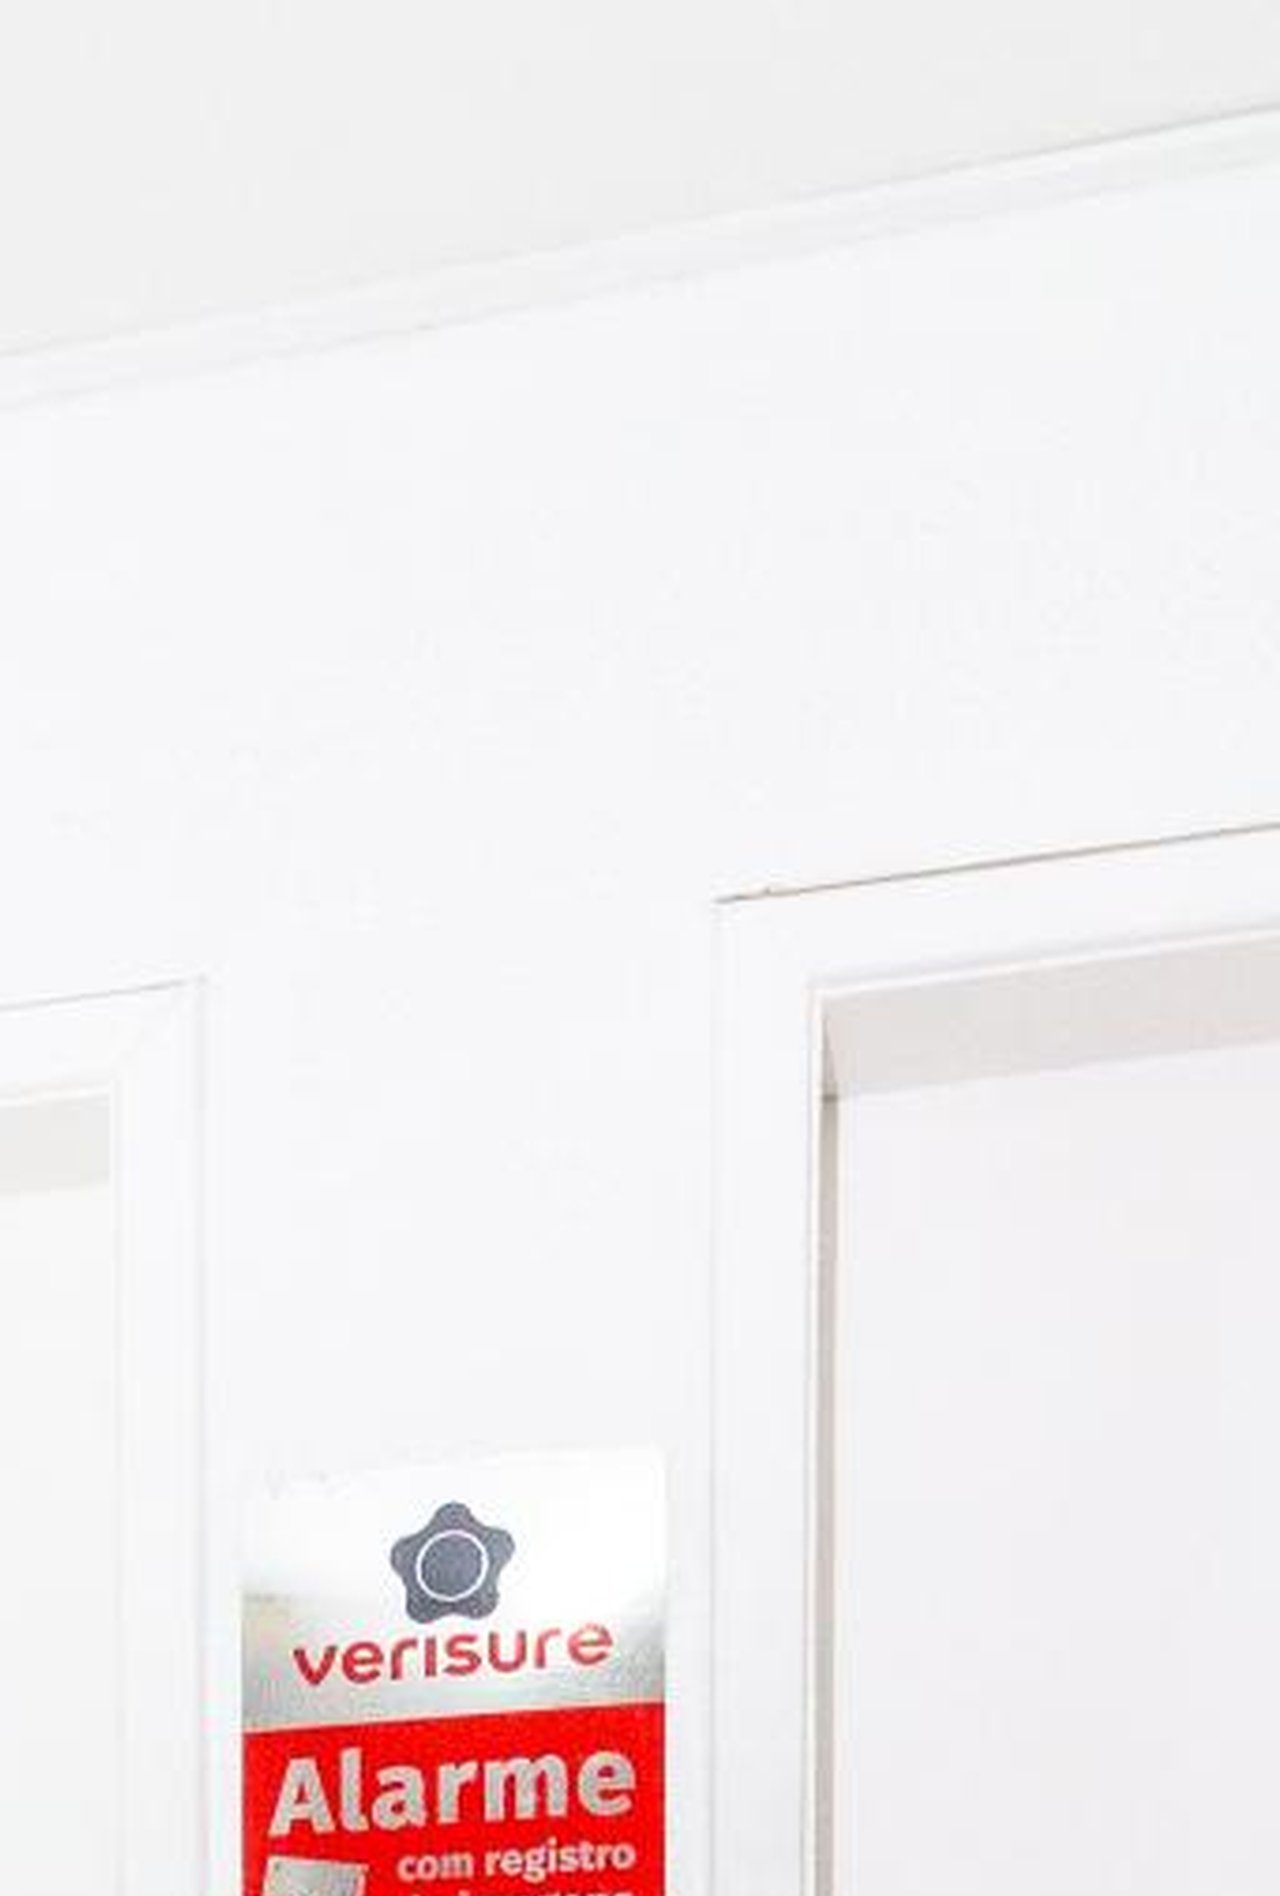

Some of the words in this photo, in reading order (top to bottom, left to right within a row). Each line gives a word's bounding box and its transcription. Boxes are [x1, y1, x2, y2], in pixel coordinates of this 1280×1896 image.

[292, 1623, 614, 1686] verisure
[268, 1746, 637, 1837] Alarme
[396, 1851, 475, 1882] com
[484, 1837, 638, 1883] registro
